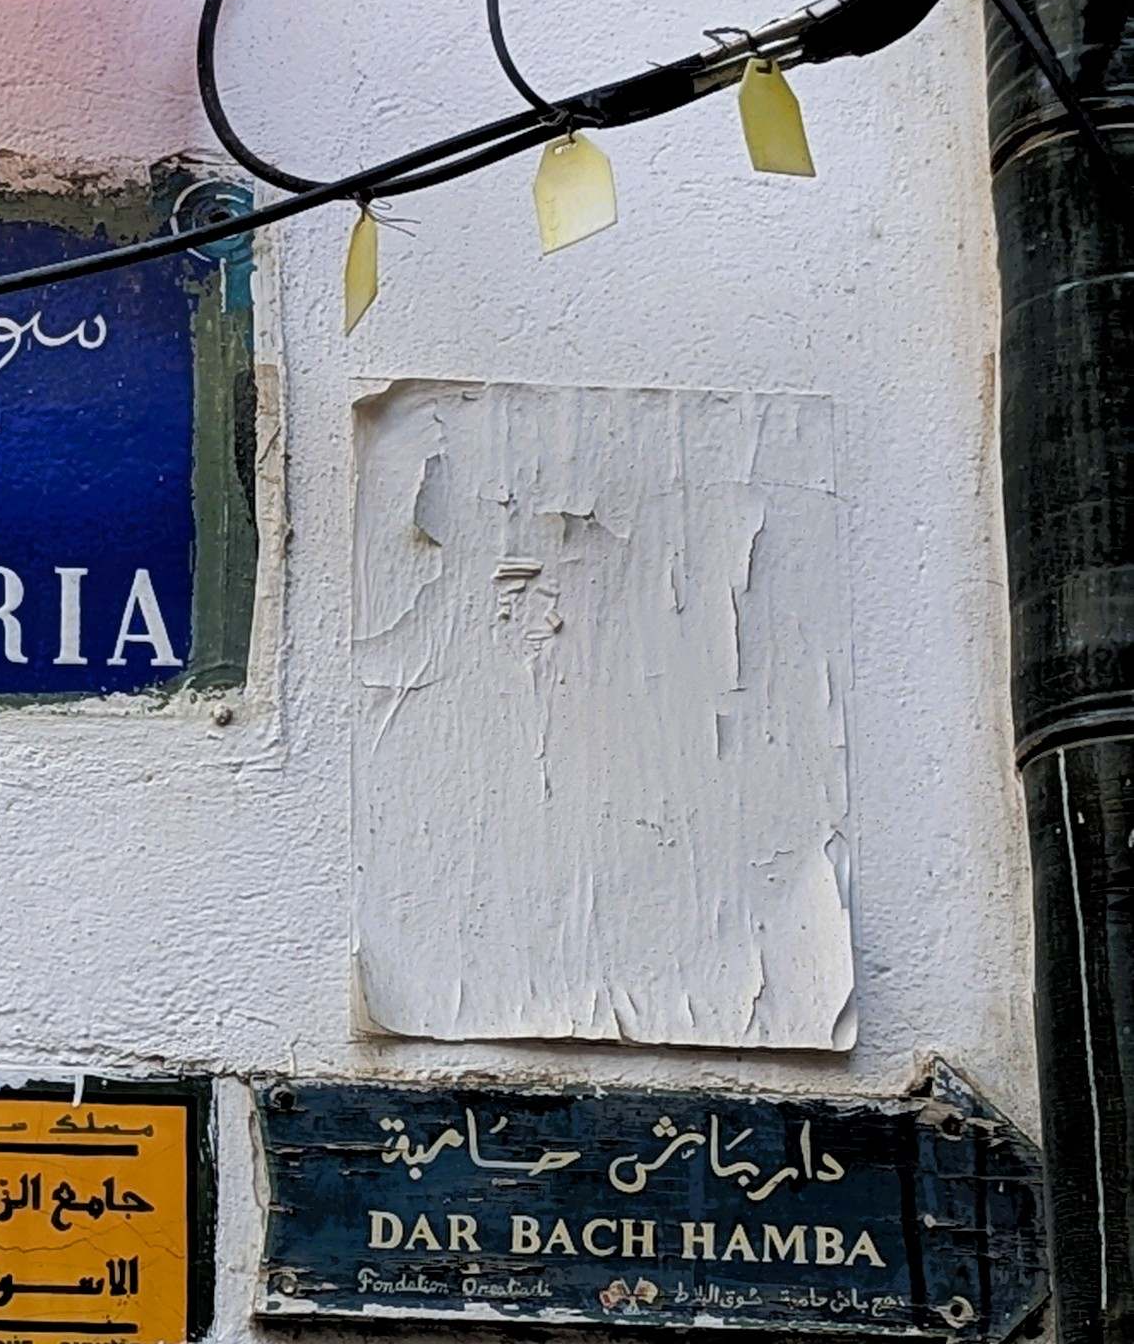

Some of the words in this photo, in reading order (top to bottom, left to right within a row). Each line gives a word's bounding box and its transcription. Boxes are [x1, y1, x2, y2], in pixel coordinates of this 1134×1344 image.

[50, 1176, 155, 1232] جامع
[369, 1211, 481, 1251] DAR
[511, 1216, 655, 1257] BACH
[682, 1223, 885, 1267] HAMBA
[357, 1267, 450, 1294] Fondation
